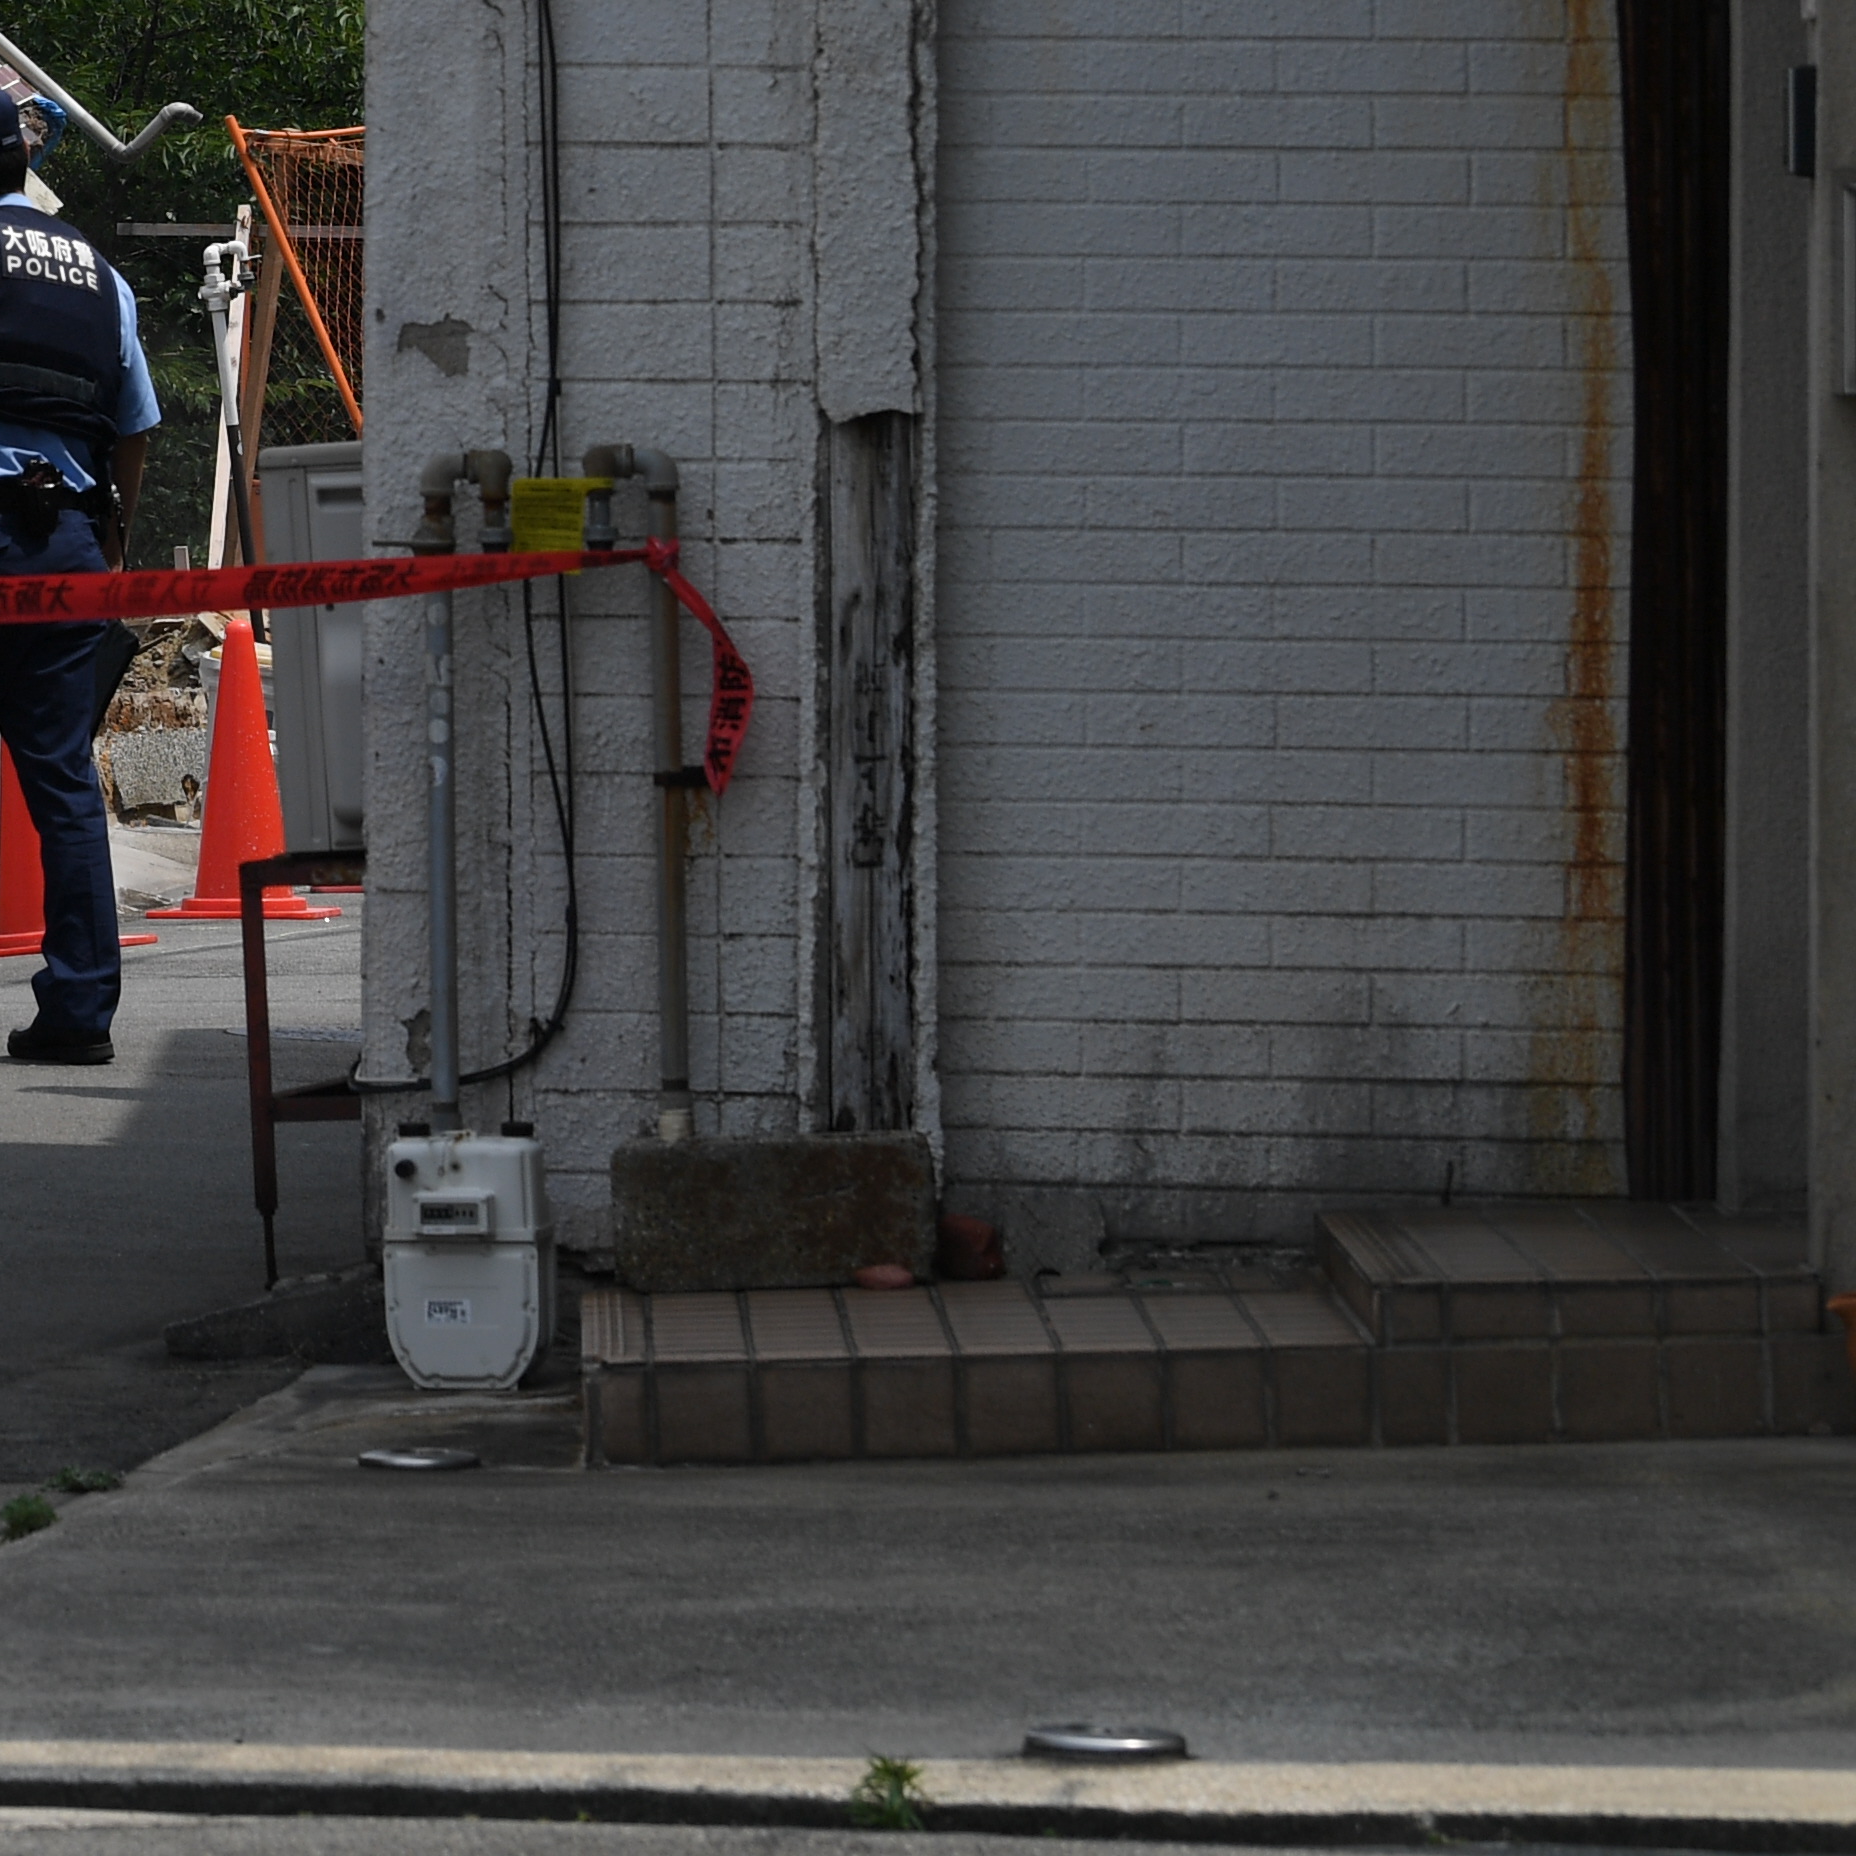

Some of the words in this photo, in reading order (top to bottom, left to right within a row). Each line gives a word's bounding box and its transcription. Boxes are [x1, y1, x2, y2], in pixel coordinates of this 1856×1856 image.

[1, 225, 96, 270] 大阪府警
[6, 254, 99, 291] POLICE
